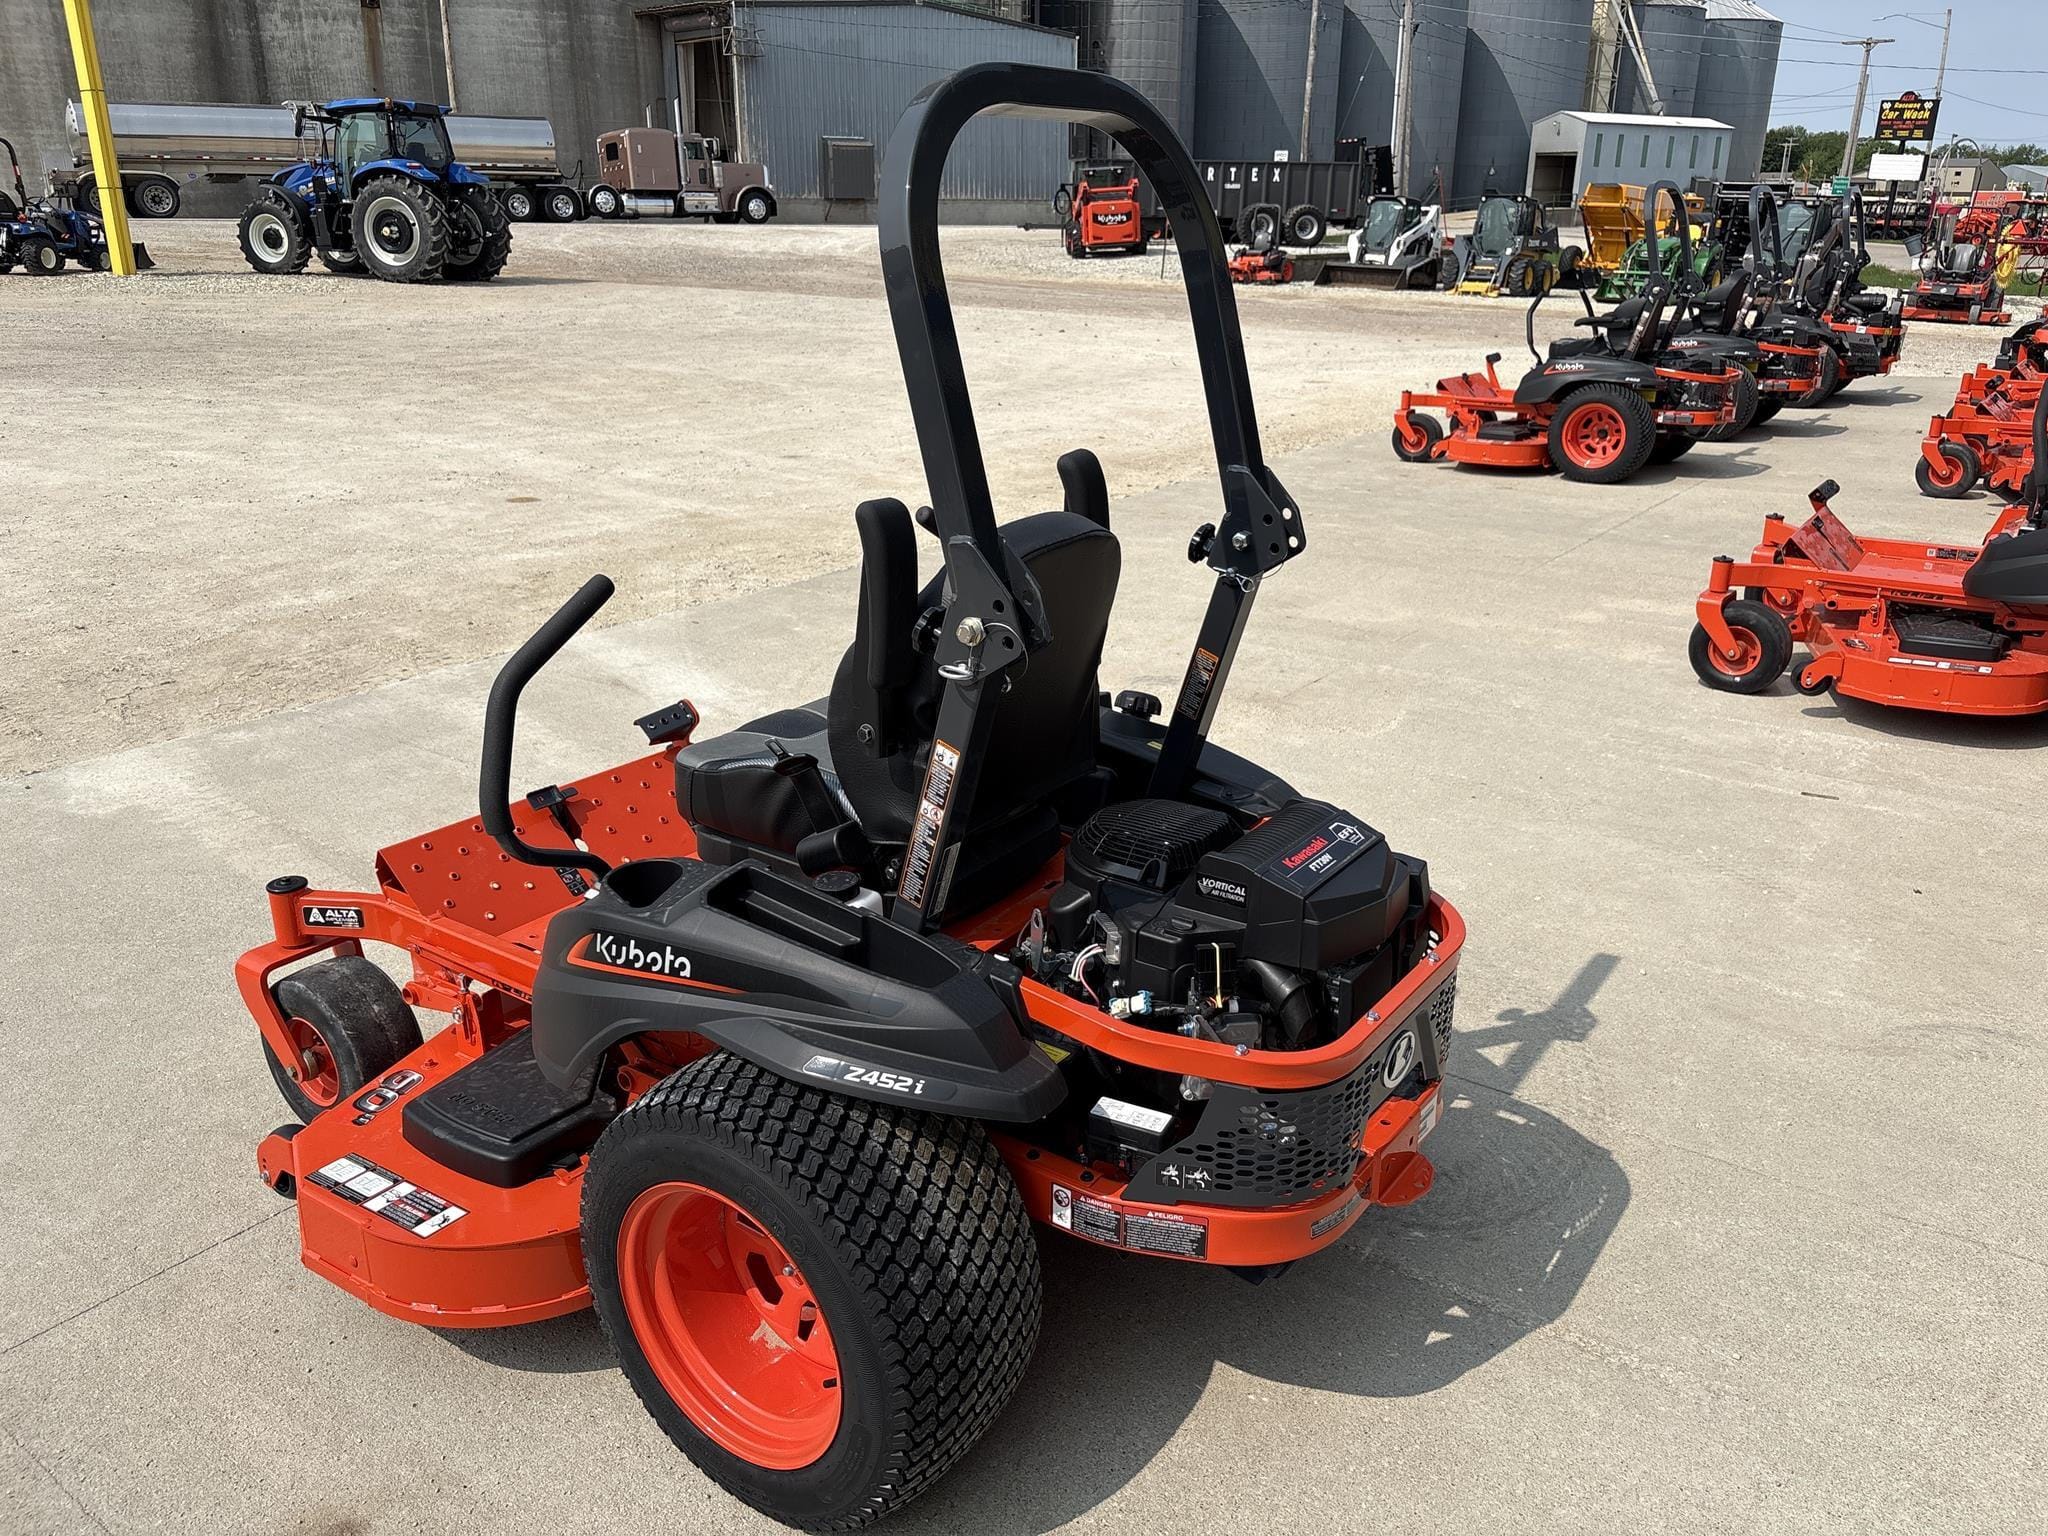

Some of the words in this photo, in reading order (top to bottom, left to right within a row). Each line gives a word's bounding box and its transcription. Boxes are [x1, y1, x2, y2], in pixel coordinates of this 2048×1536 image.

[1881, 110, 1899, 119] Car
[1903, 109, 1930, 119] Wash
[1098, 214, 1127, 222] Kubota
[1281, 836, 1328, 869] Kawasaki
[1202, 877, 1246, 897] VORTICAL
[325, 909, 358, 918] ALTA
[596, 932, 692, 978] Kubota
[1086, 1197, 1112, 1210] DANGER
[1154, 1211, 1184, 1222] PELIGRO
